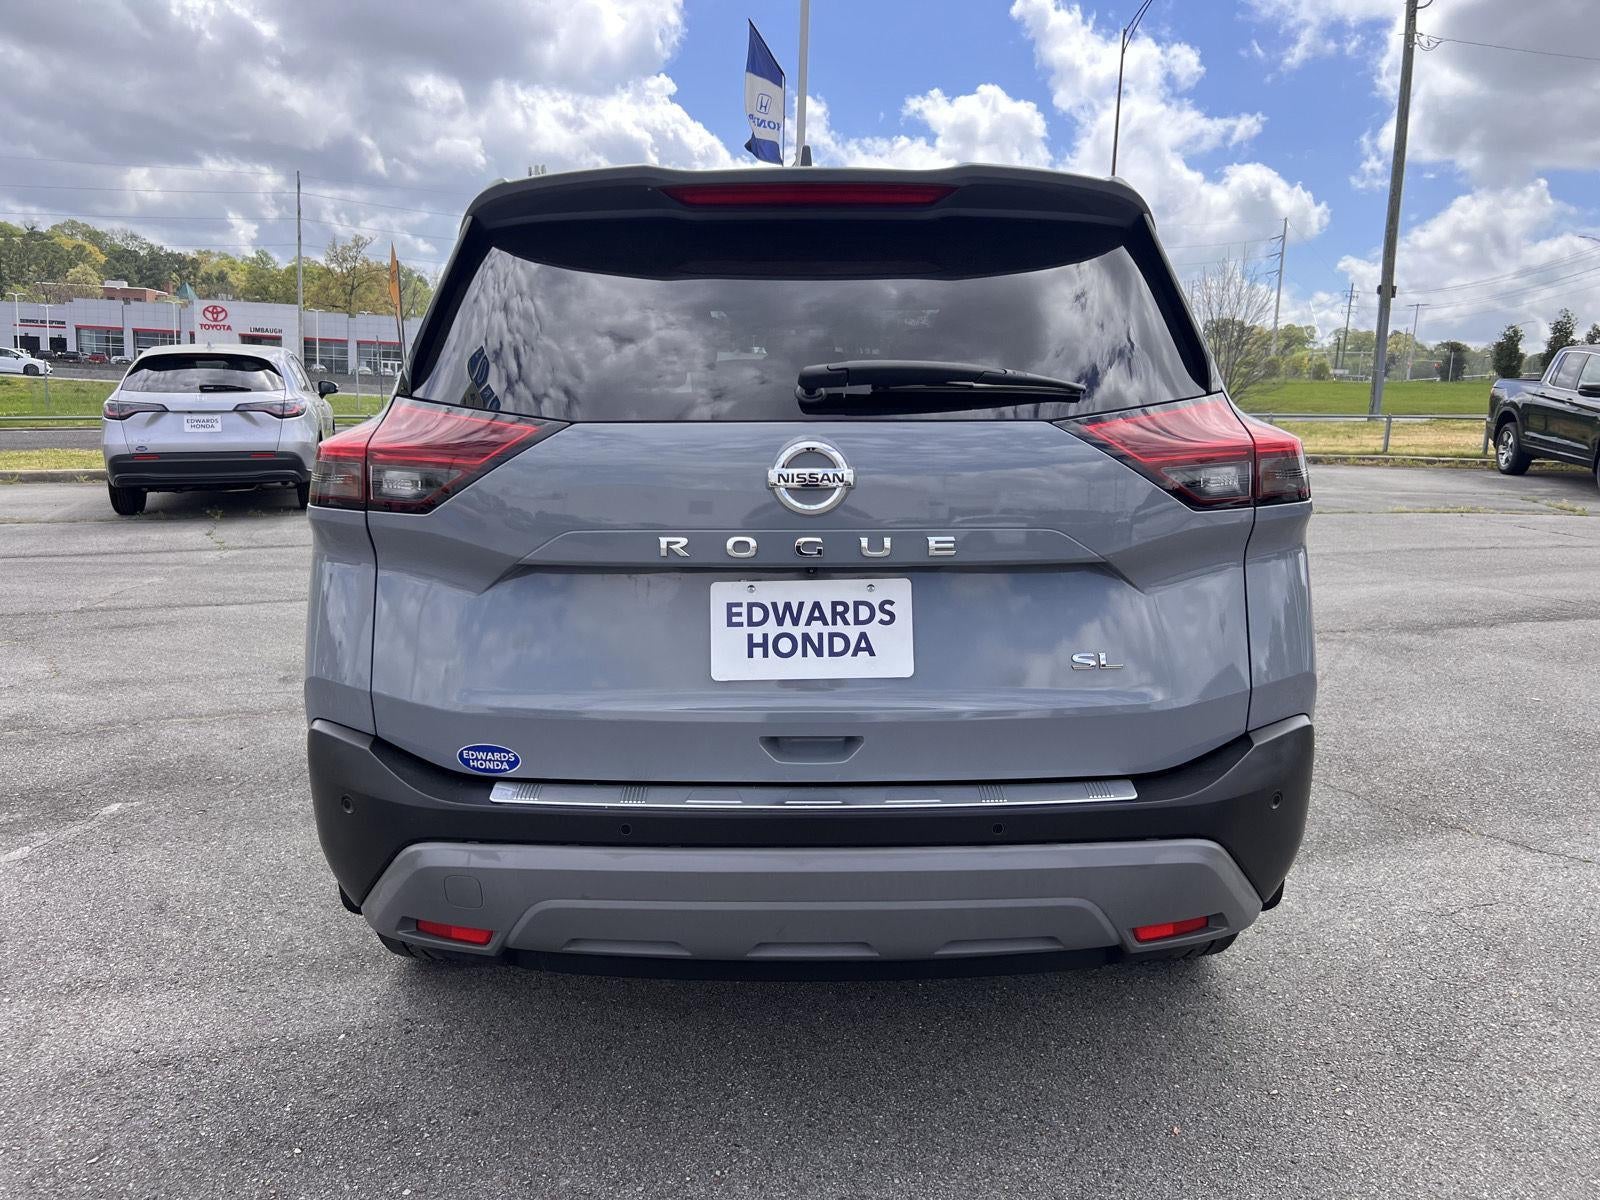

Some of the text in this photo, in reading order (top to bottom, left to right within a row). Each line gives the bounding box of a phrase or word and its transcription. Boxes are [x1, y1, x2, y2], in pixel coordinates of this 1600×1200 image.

[199, 323, 232, 331] TOYOTA
[249, 326, 283, 334] LIMBAUGH
[776, 472, 846, 484] NISSAN
[658, 536, 957, 558] ROGUE
[726, 599, 896, 628] EDWARDS
[747, 631, 877, 659] HONDA
[1071, 652, 1124, 670] SL
[463, 750, 515, 761] EDWARDS
[469, 760, 510, 770] HONDA
